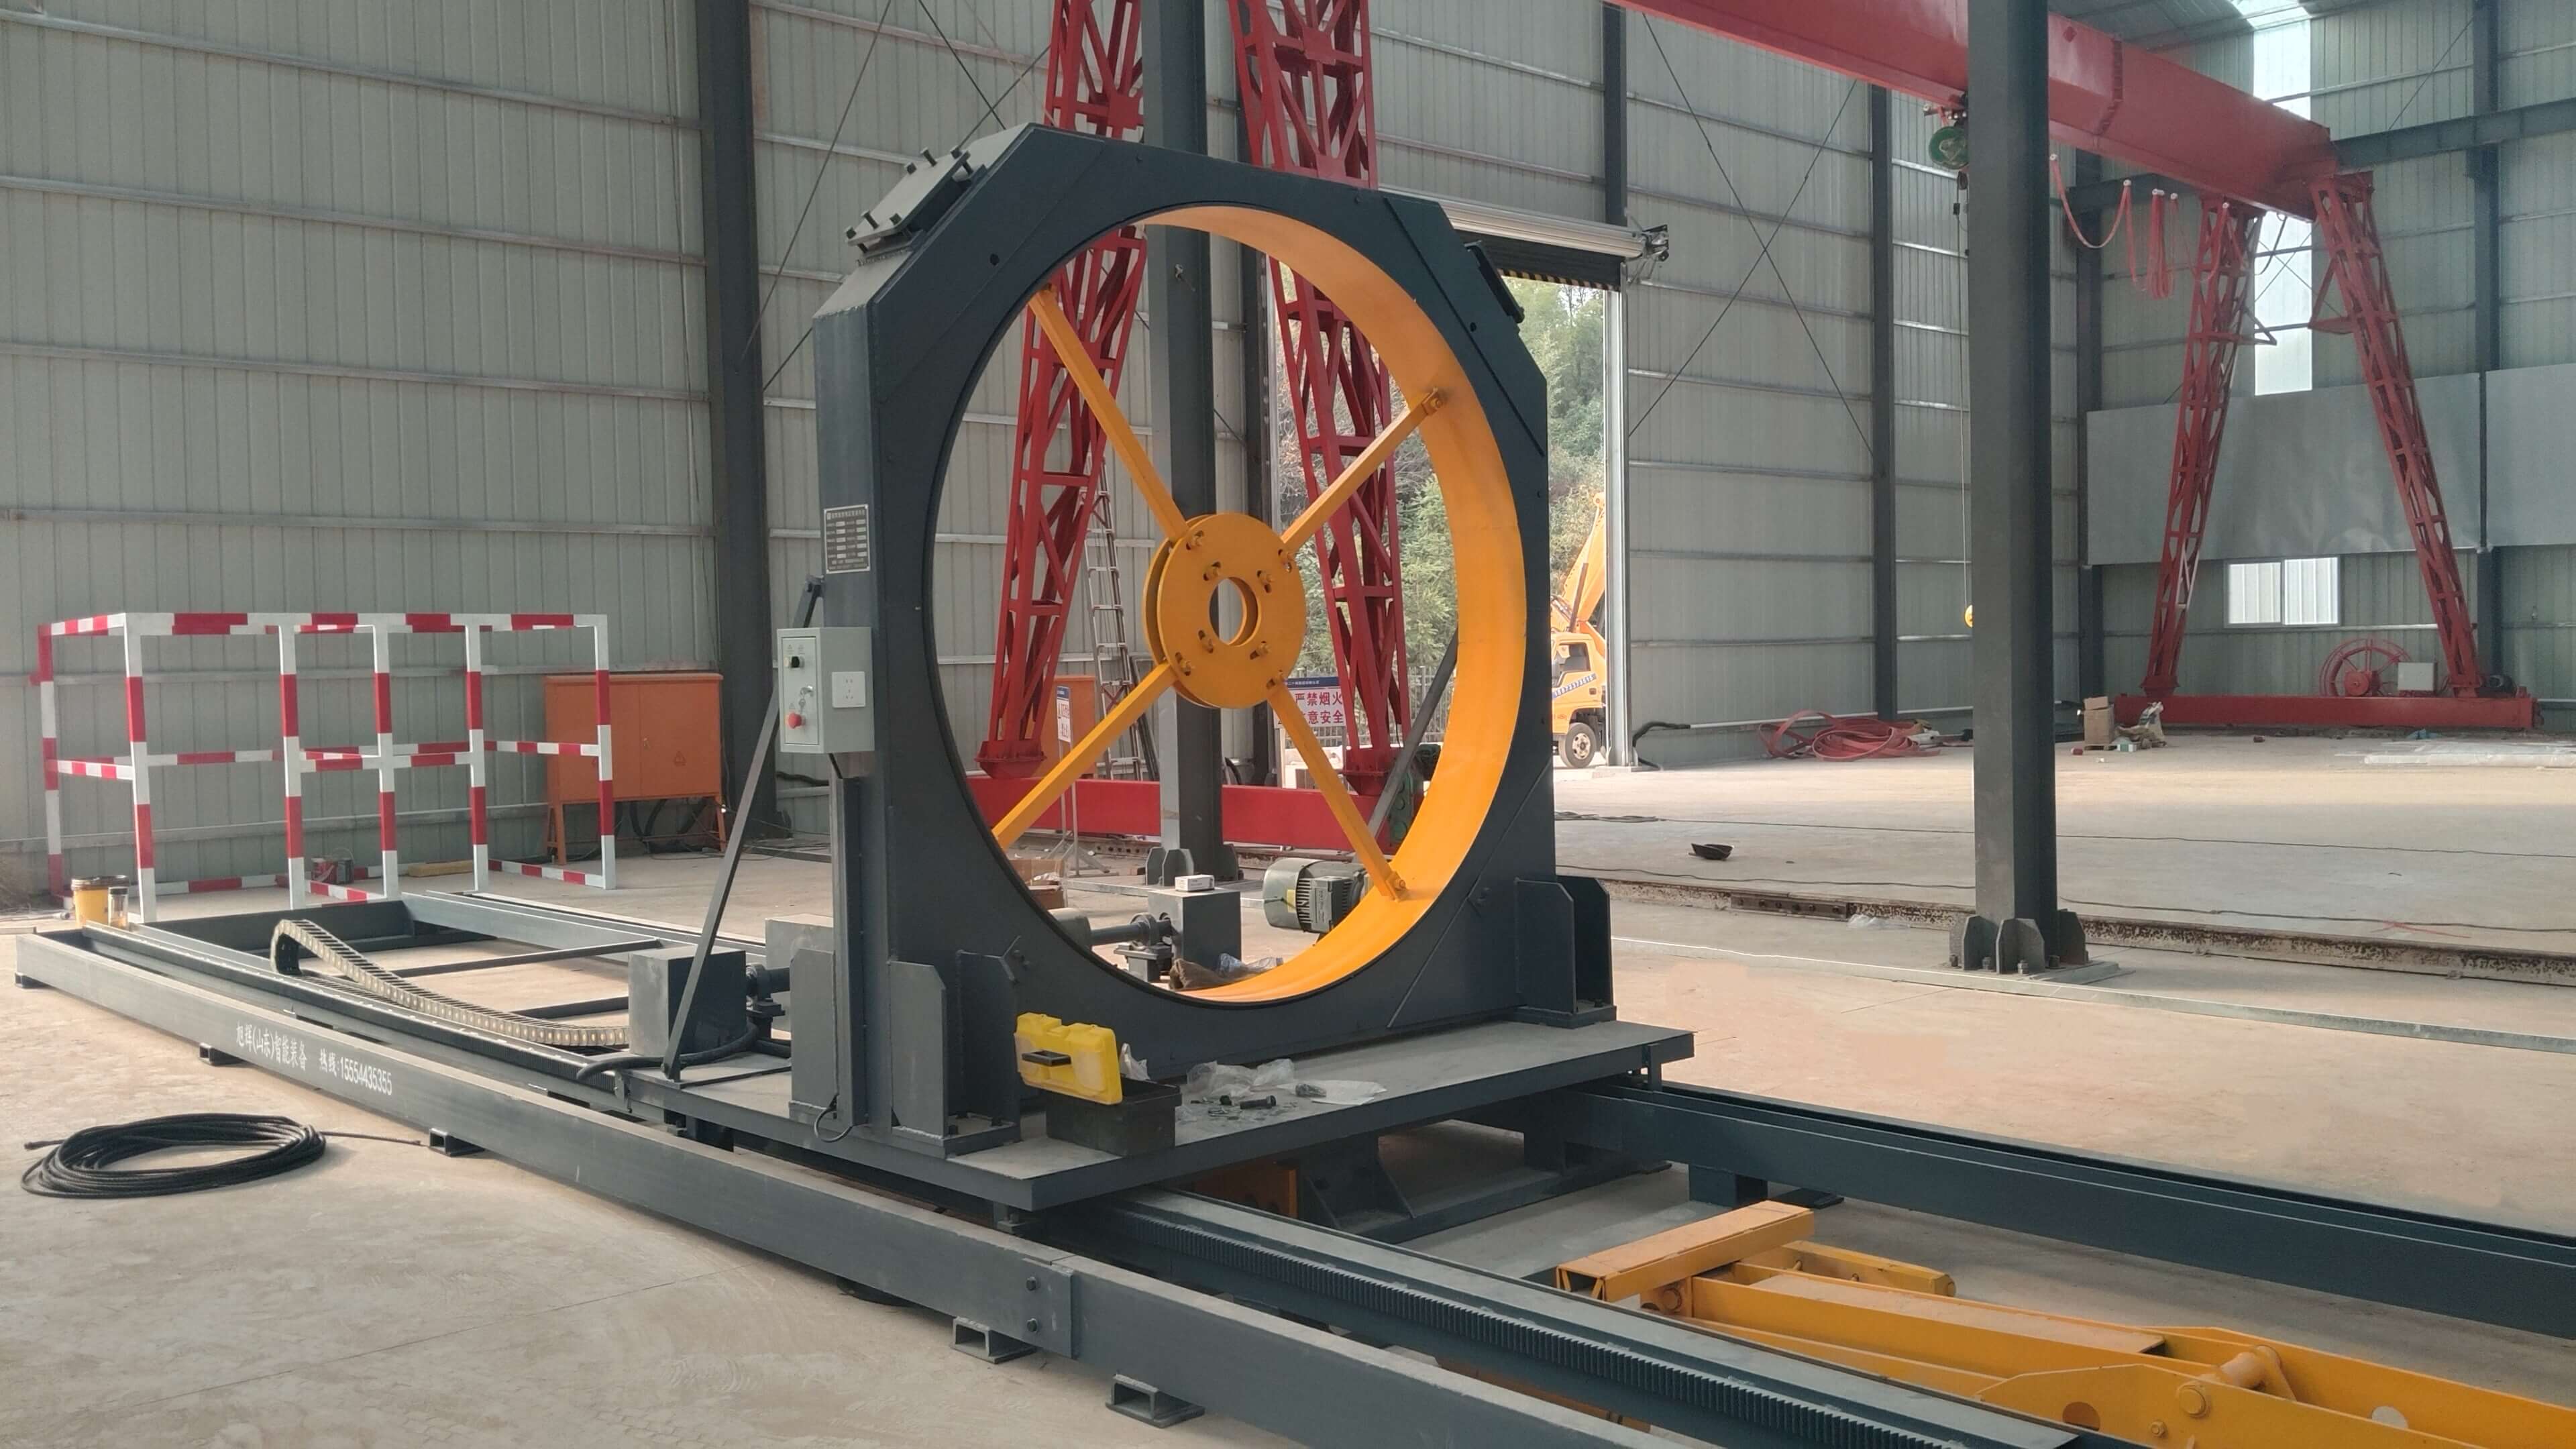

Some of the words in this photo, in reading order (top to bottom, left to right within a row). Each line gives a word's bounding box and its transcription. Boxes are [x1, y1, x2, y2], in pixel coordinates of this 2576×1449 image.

[1295, 692, 1342, 706] 严禁烟火
[1303, 710, 1343, 724] 意安全
